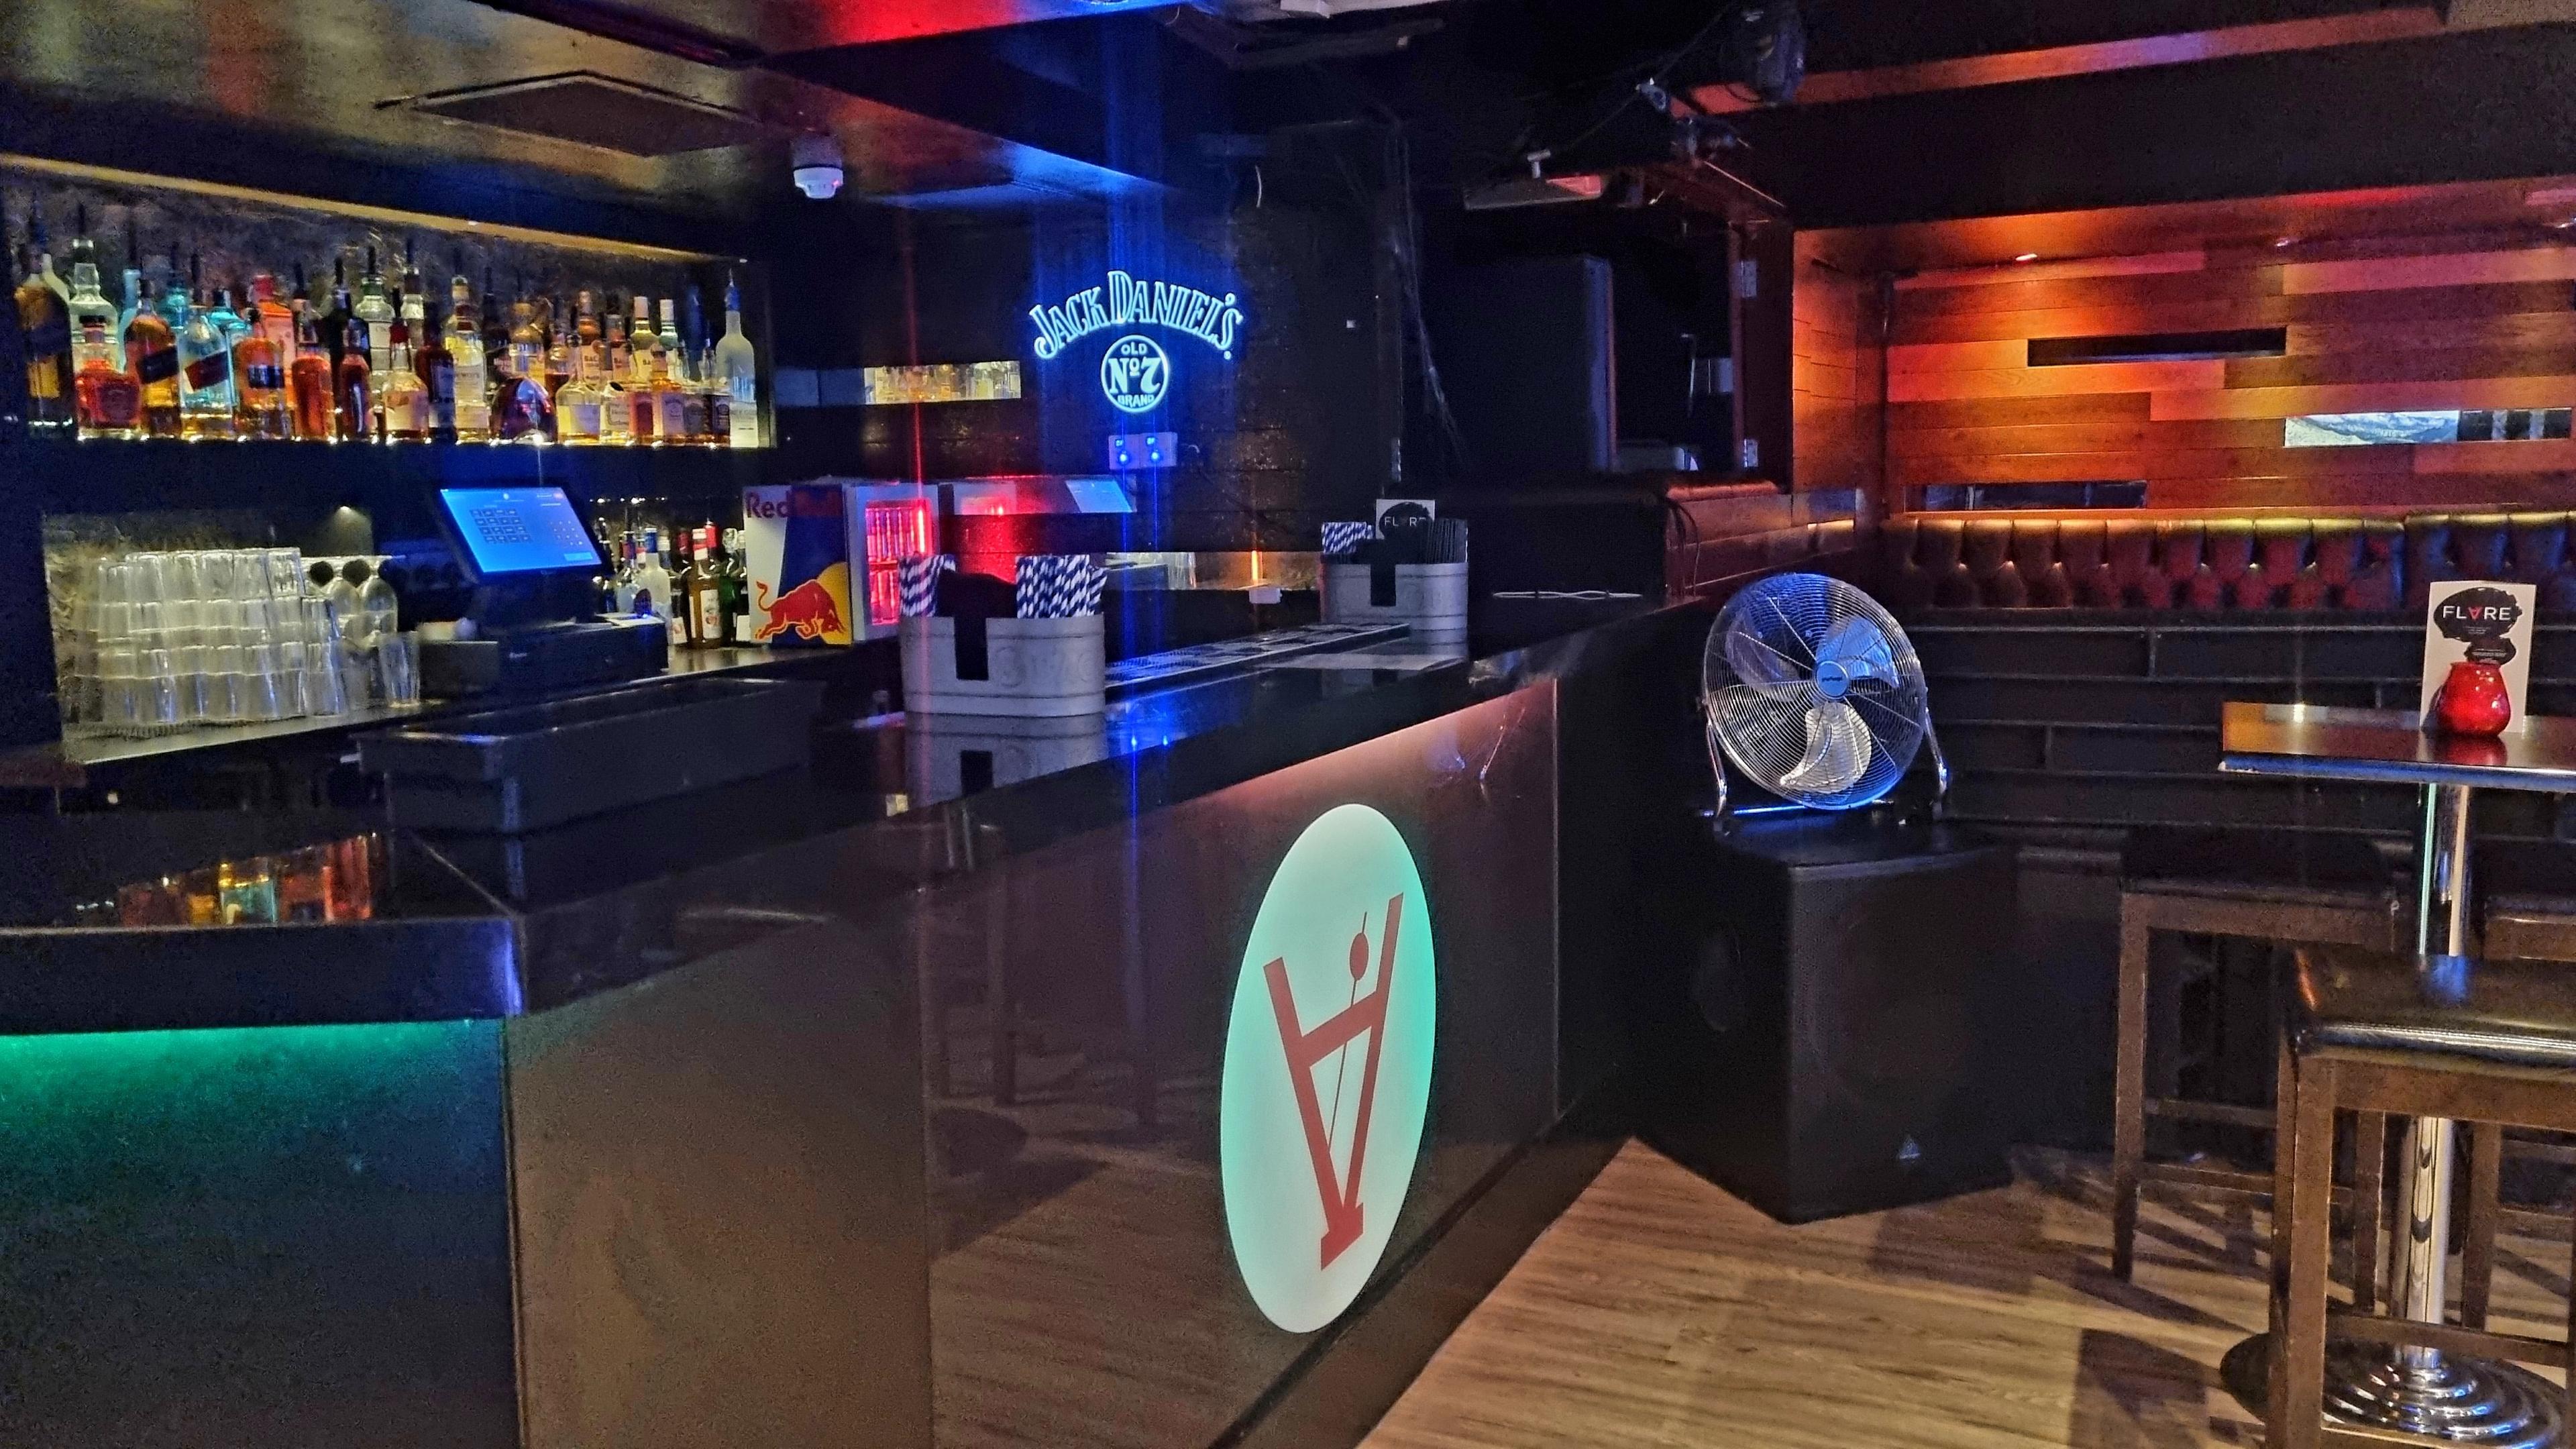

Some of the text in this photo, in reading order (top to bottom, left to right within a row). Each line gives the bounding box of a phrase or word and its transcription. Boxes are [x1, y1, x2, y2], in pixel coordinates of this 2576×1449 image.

[1028, 270, 1244, 359] JACK DANIEL'S
[1121, 341, 1147, 355] OLD
[1117, 394, 1155, 408] BRAND
